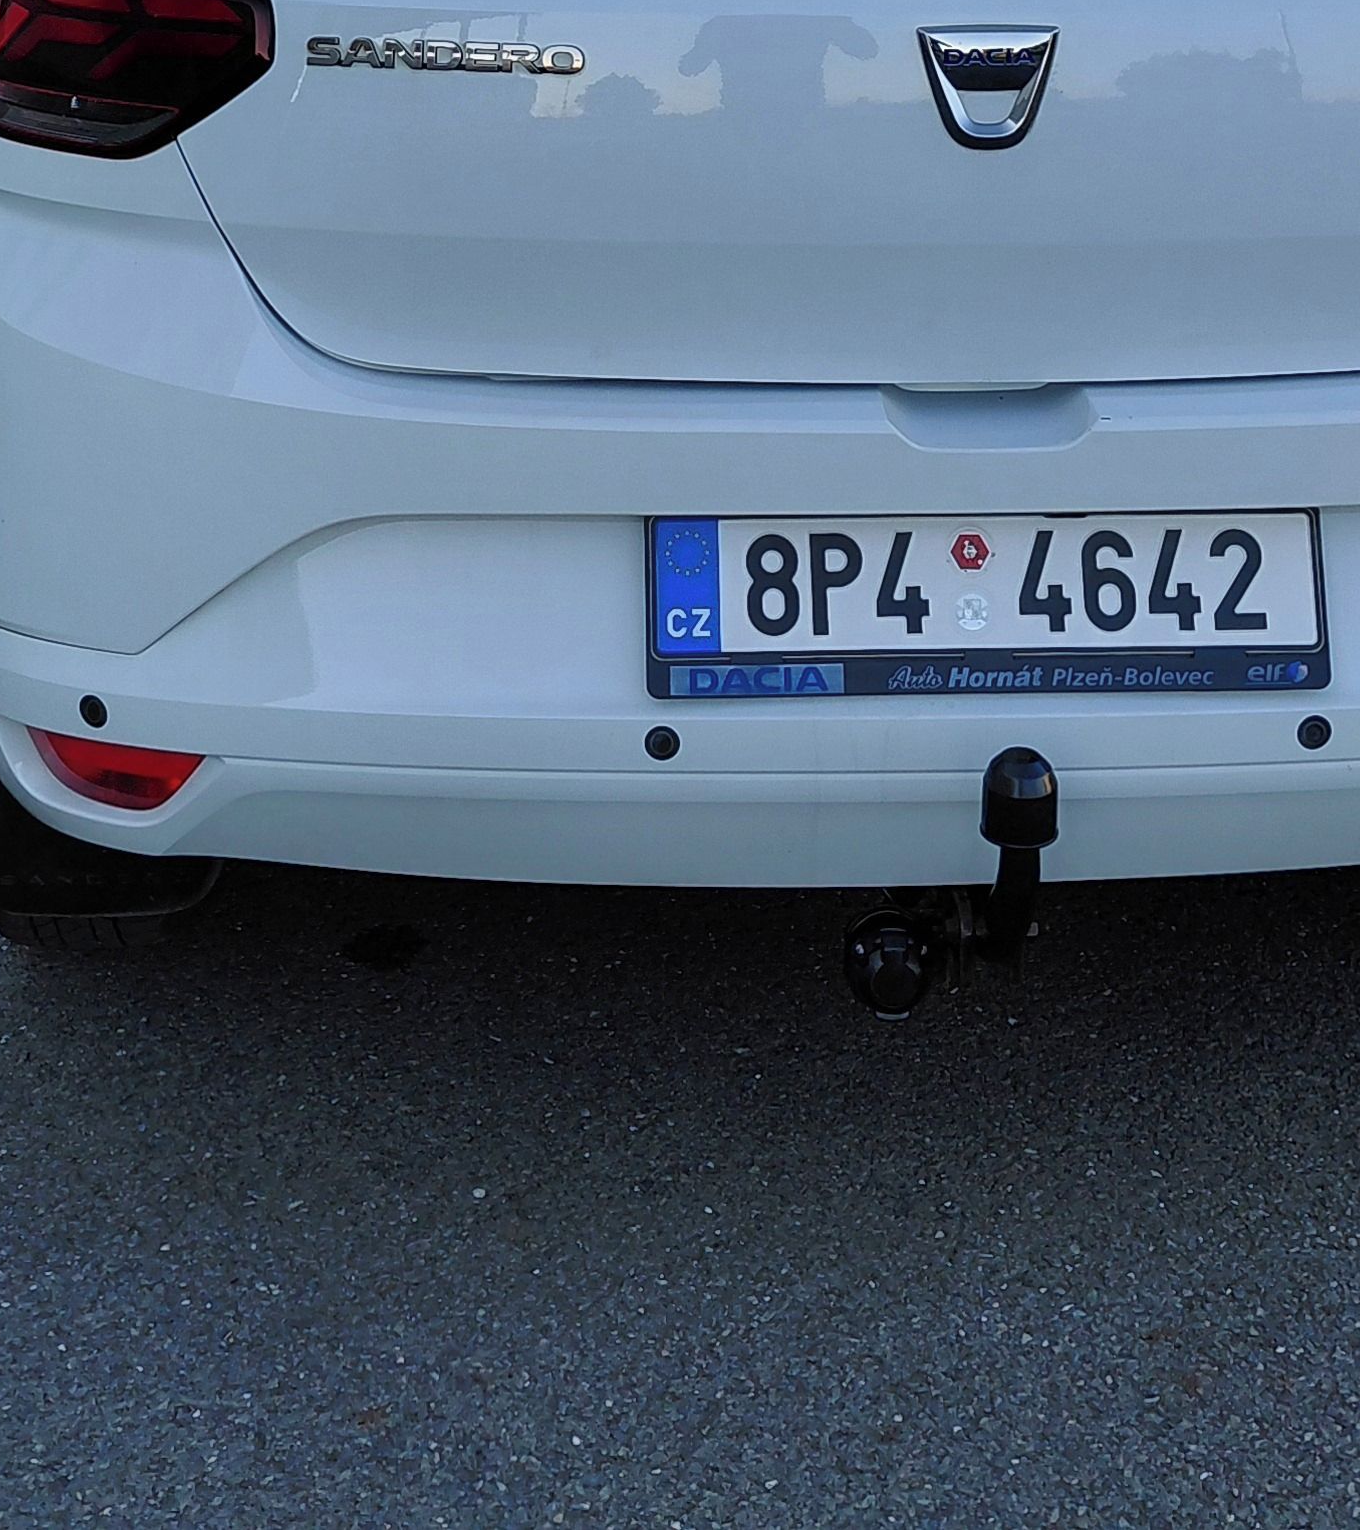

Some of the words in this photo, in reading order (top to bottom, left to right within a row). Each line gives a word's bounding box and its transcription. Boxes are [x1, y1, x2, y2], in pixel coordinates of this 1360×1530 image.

[306, 36, 586, 75] SANDERO
[943, 48, 1037, 67] DACIA
[746, 531, 930, 637] 8P4
[1019, 528, 1268, 632] 4642
[666, 608, 711, 638] CZ
[689, 666, 828, 694] DACIA
[888, 665, 943, 690] Auto
[948, 664, 1042, 689] Hornát
[1051, 665, 1214, 688] Plzeň-Bolevec
[1247, 663, 1287, 683] elf
